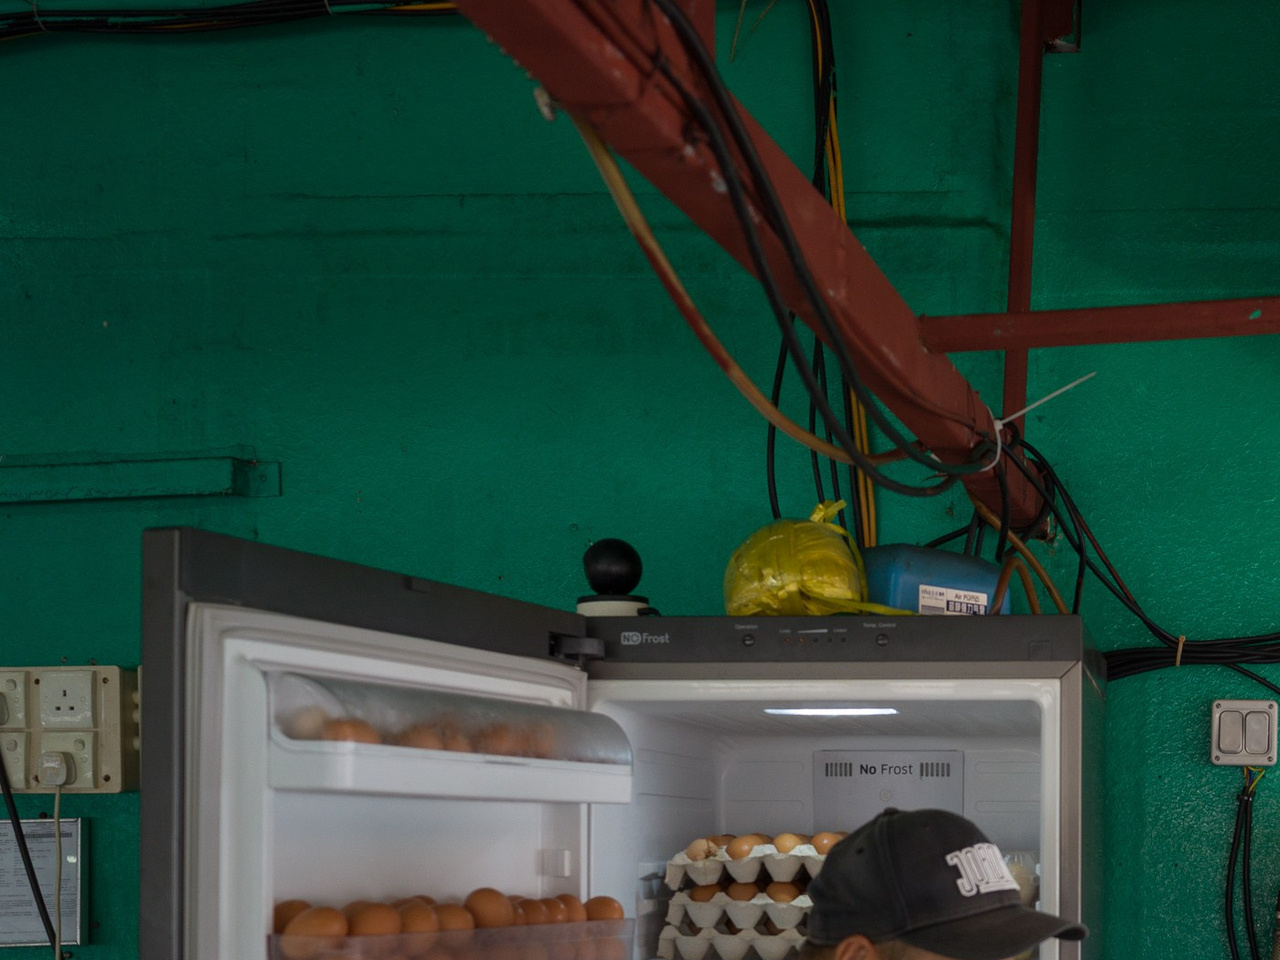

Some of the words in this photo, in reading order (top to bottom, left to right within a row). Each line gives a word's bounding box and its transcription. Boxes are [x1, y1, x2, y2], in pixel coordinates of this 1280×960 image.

[642, 632, 670, 644] Frost
[860, 764, 876, 775] No
[881, 764, 913, 775] Frost
